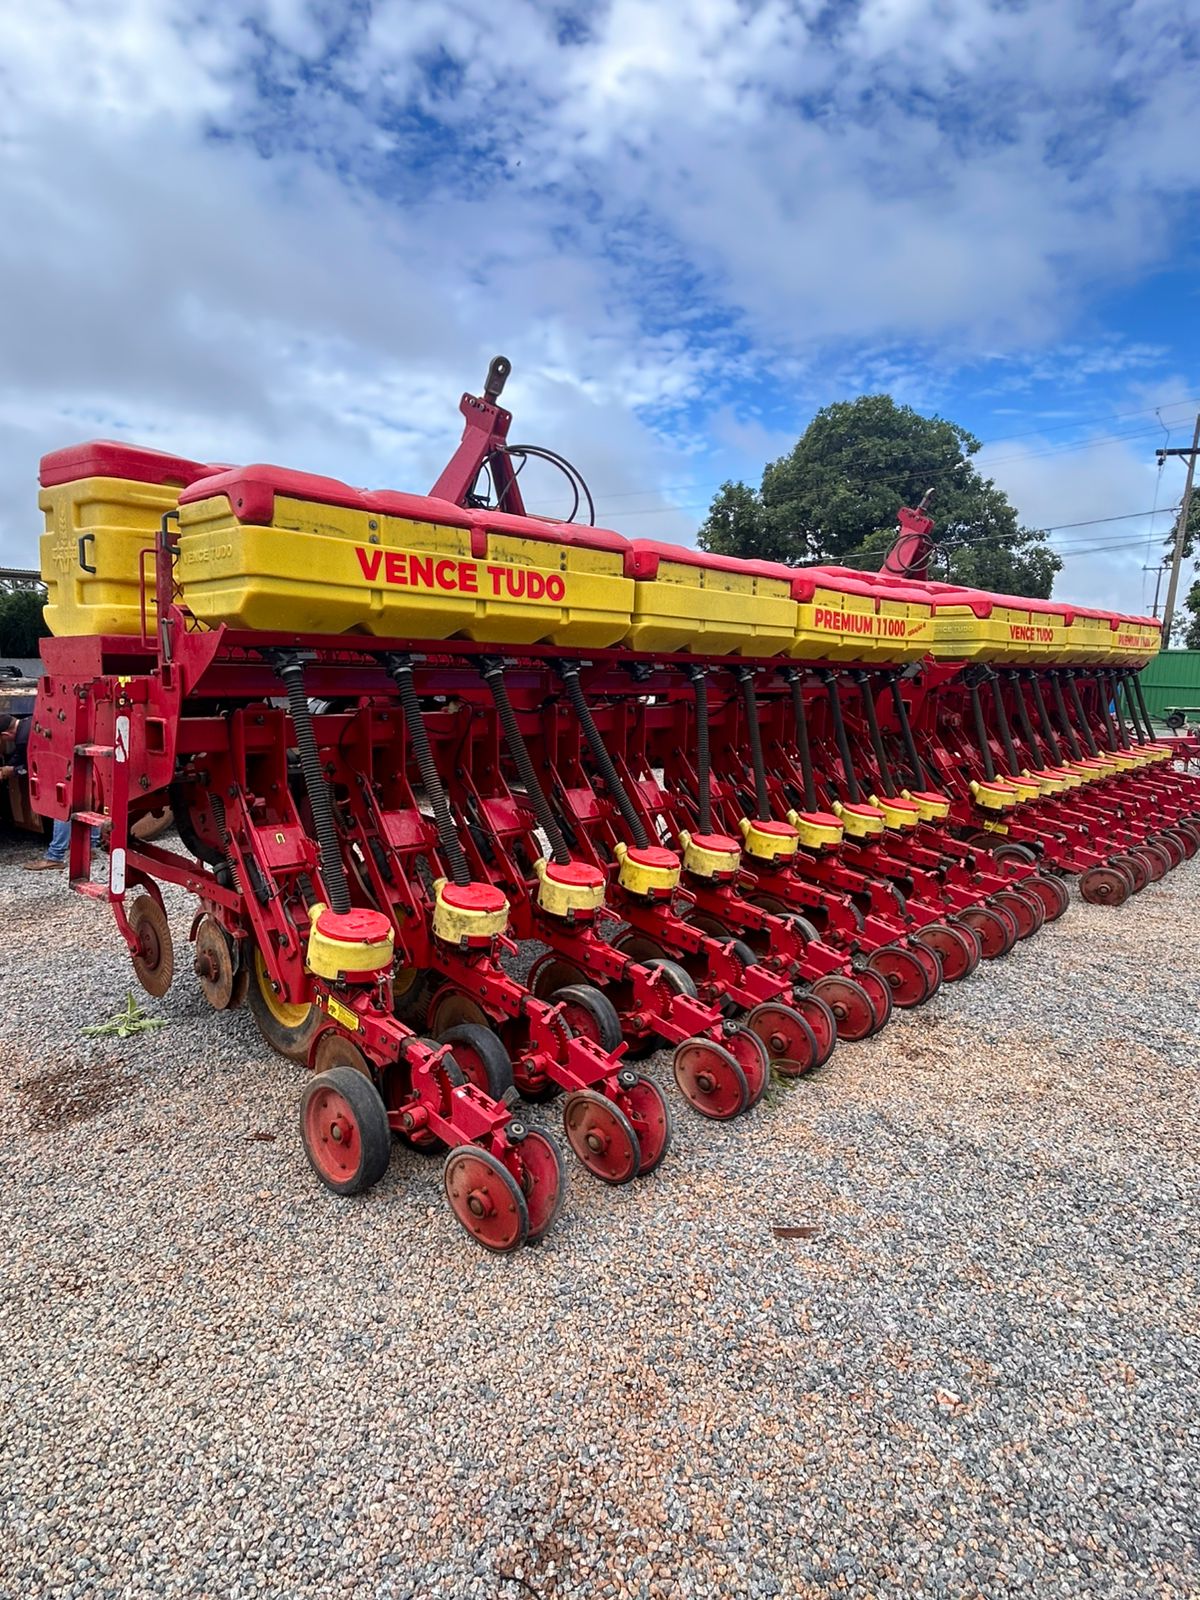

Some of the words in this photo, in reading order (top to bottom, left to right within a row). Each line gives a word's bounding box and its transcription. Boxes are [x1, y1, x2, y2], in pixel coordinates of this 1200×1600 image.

[183, 549, 209, 565] VENCE
[210, 544, 233, 560] TUDO
[355, 547, 479, 593] VENCE
[487, 566, 565, 602] TUDO
[814, 608, 873, 635] PREMIUM
[876, 618, 906, 637] 11000
[1010, 625, 1035, 641] VENCE
[1036, 627, 1054, 642] TUDO
